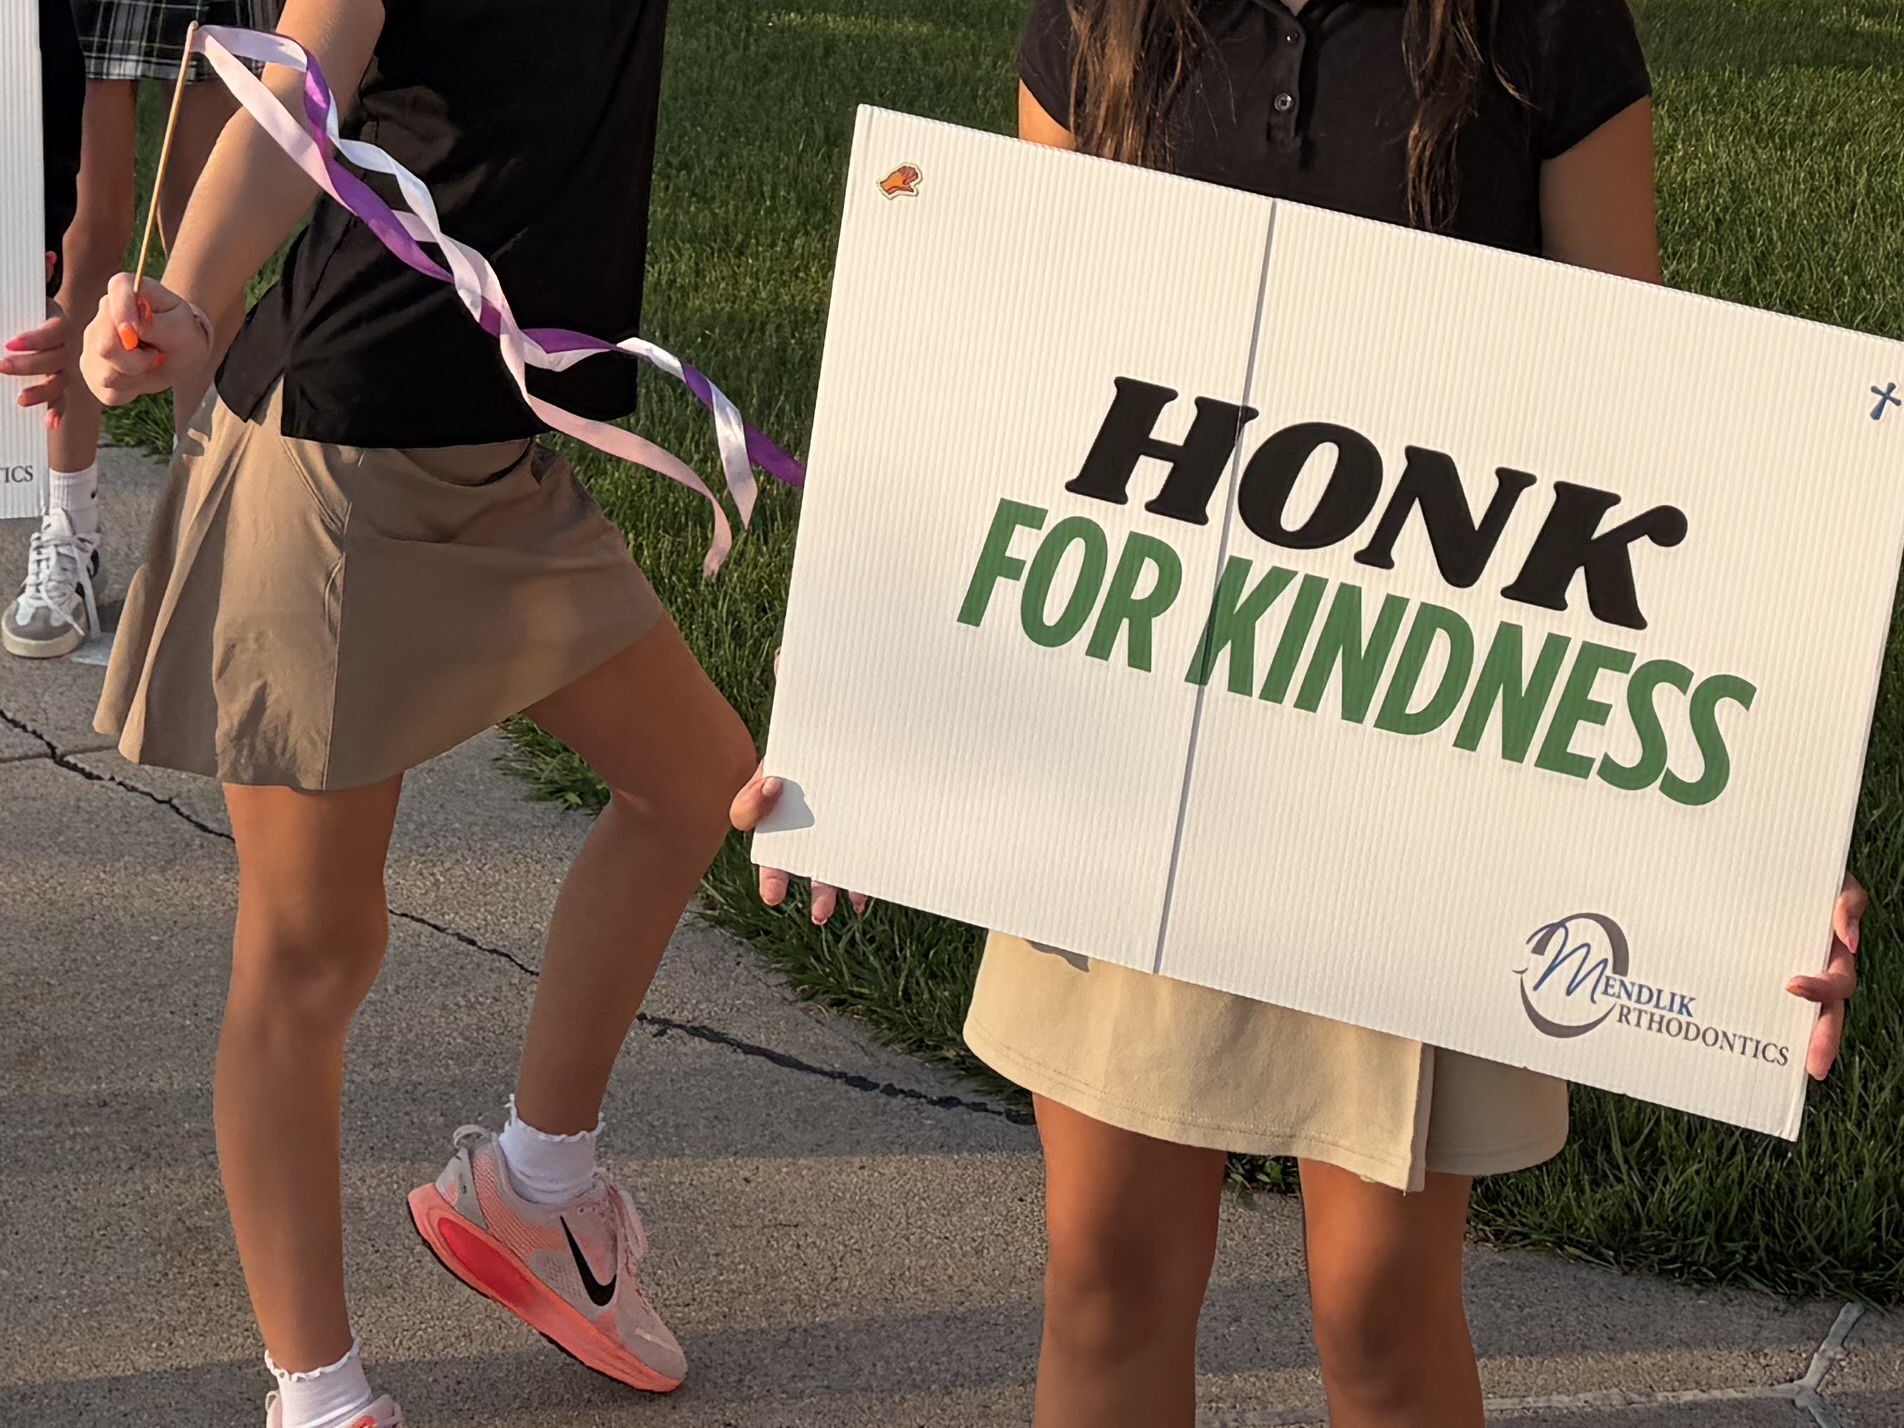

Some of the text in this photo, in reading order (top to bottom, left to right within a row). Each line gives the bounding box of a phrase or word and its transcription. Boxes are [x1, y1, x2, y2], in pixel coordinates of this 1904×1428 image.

[1066, 376, 1688, 631] HONK
[957, 498, 1757, 806] FOR KINDNESS
[1526, 922, 1696, 1018] MENDLIK
